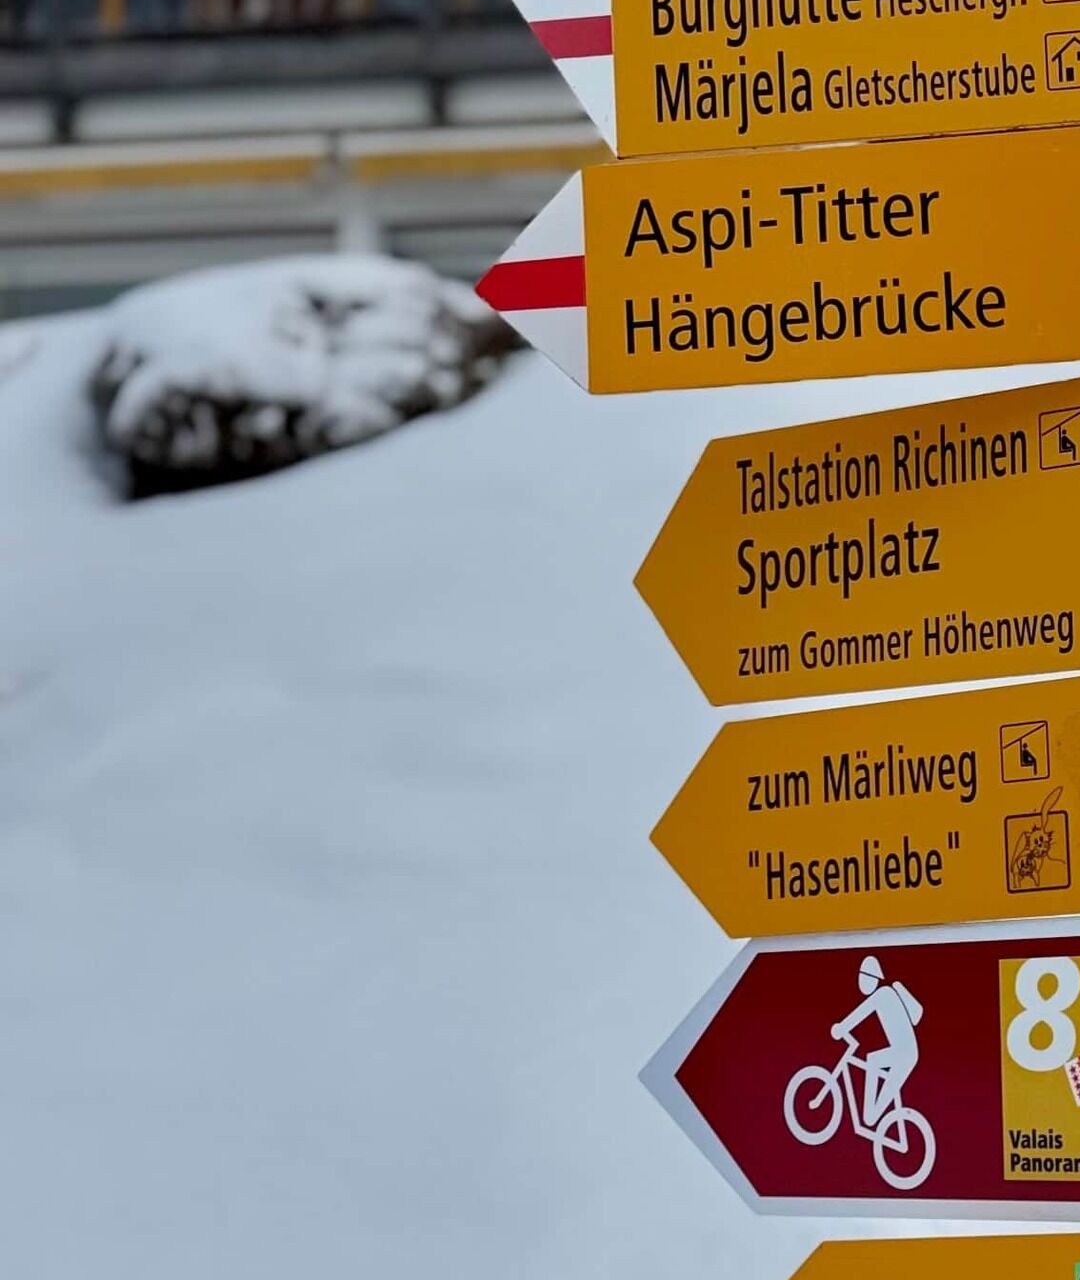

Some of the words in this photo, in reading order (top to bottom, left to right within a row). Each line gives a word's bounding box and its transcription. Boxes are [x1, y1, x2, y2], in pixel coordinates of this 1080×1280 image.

[654, 51, 813, 135] Märjela
[824, 53, 1036, 110] Gletscherstube
[623, 183, 940, 269] Aspi-Titter
[625, 271, 1006, 363] Hängebrücke
[736, 442, 881, 515] Talstation
[893, 423, 1028, 493] Richinen
[737, 518, 941, 608] Sportplatz
[738, 639, 790, 677] zum
[800, 626, 913, 670] Gommer
[923, 608, 1074, 656] Höhenweg
[748, 770, 810, 812] zum
[822, 744, 978, 804] Märliweg
[748, 831, 960, 900] "Hasenliebe"
[1009, 1129, 1063, 1150] Valais
